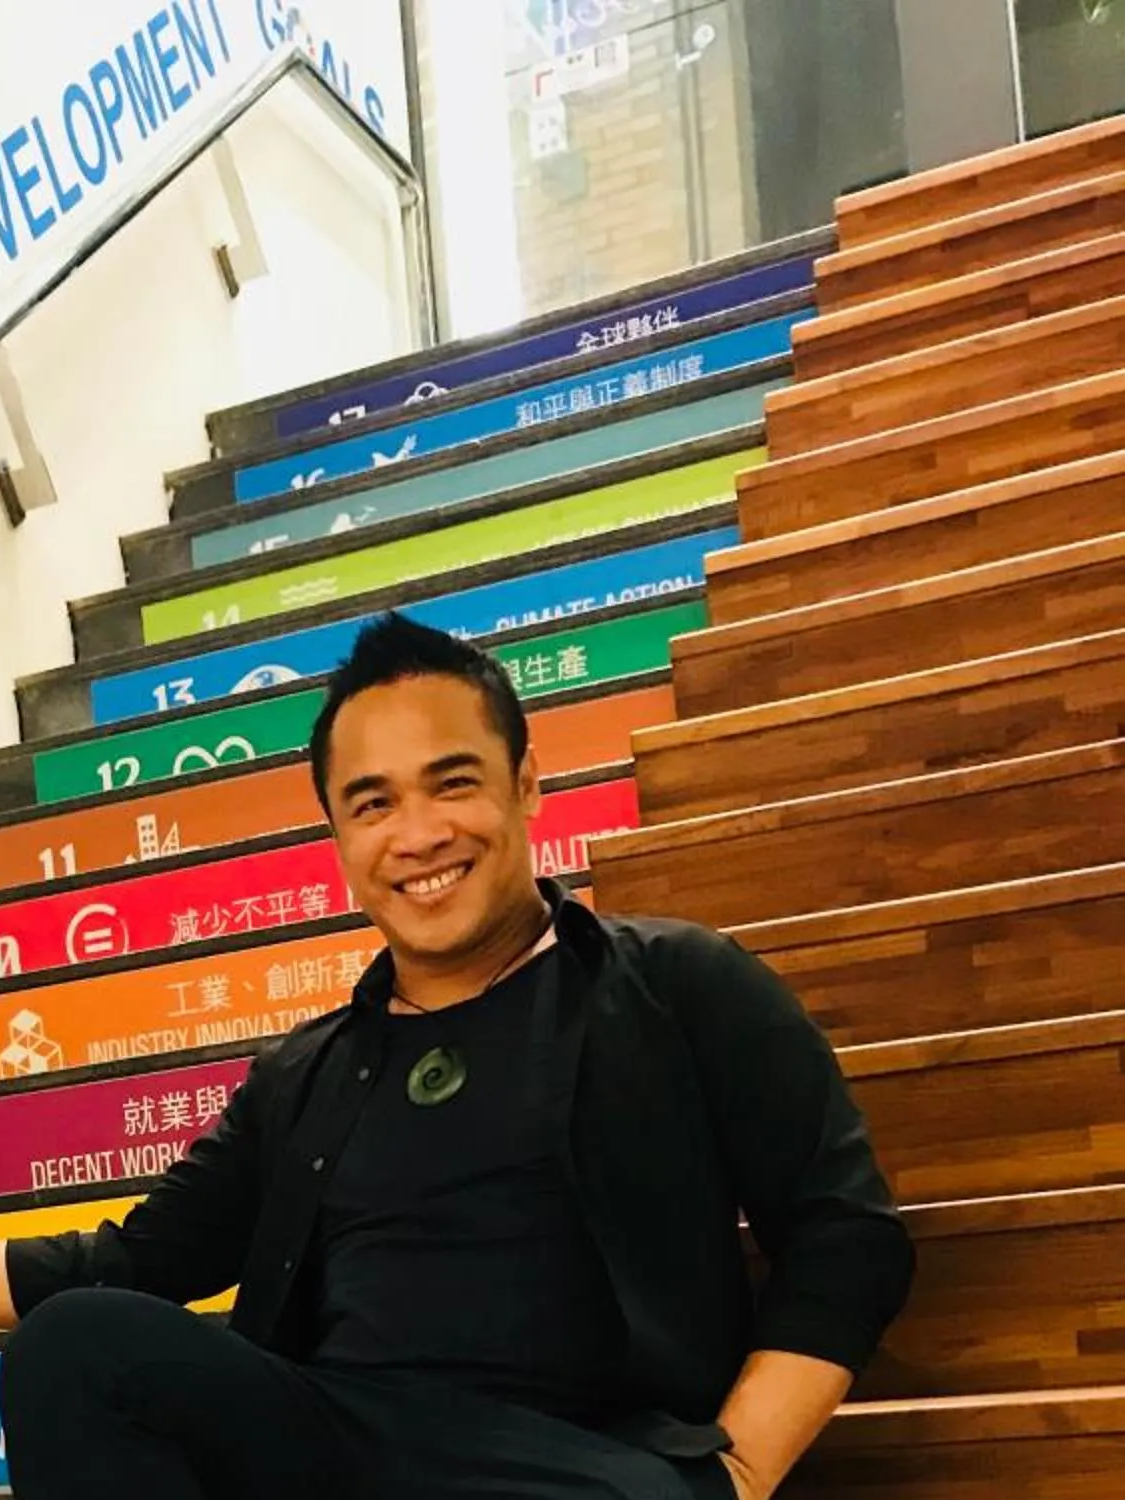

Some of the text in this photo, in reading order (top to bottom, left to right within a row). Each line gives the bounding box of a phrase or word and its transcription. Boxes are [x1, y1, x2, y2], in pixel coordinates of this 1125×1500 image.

[97, 757, 140, 791] 12
[37, 842, 75, 880] 11
[170, 883, 330, 943] 減少不平等
[166, 948, 379, 1018] 工業、創新基
[87, 1027, 192, 1065] INDUSTRY
[123, 1081, 242, 1136] 就業與
[30, 1139, 187, 1190] DECENT WORK
